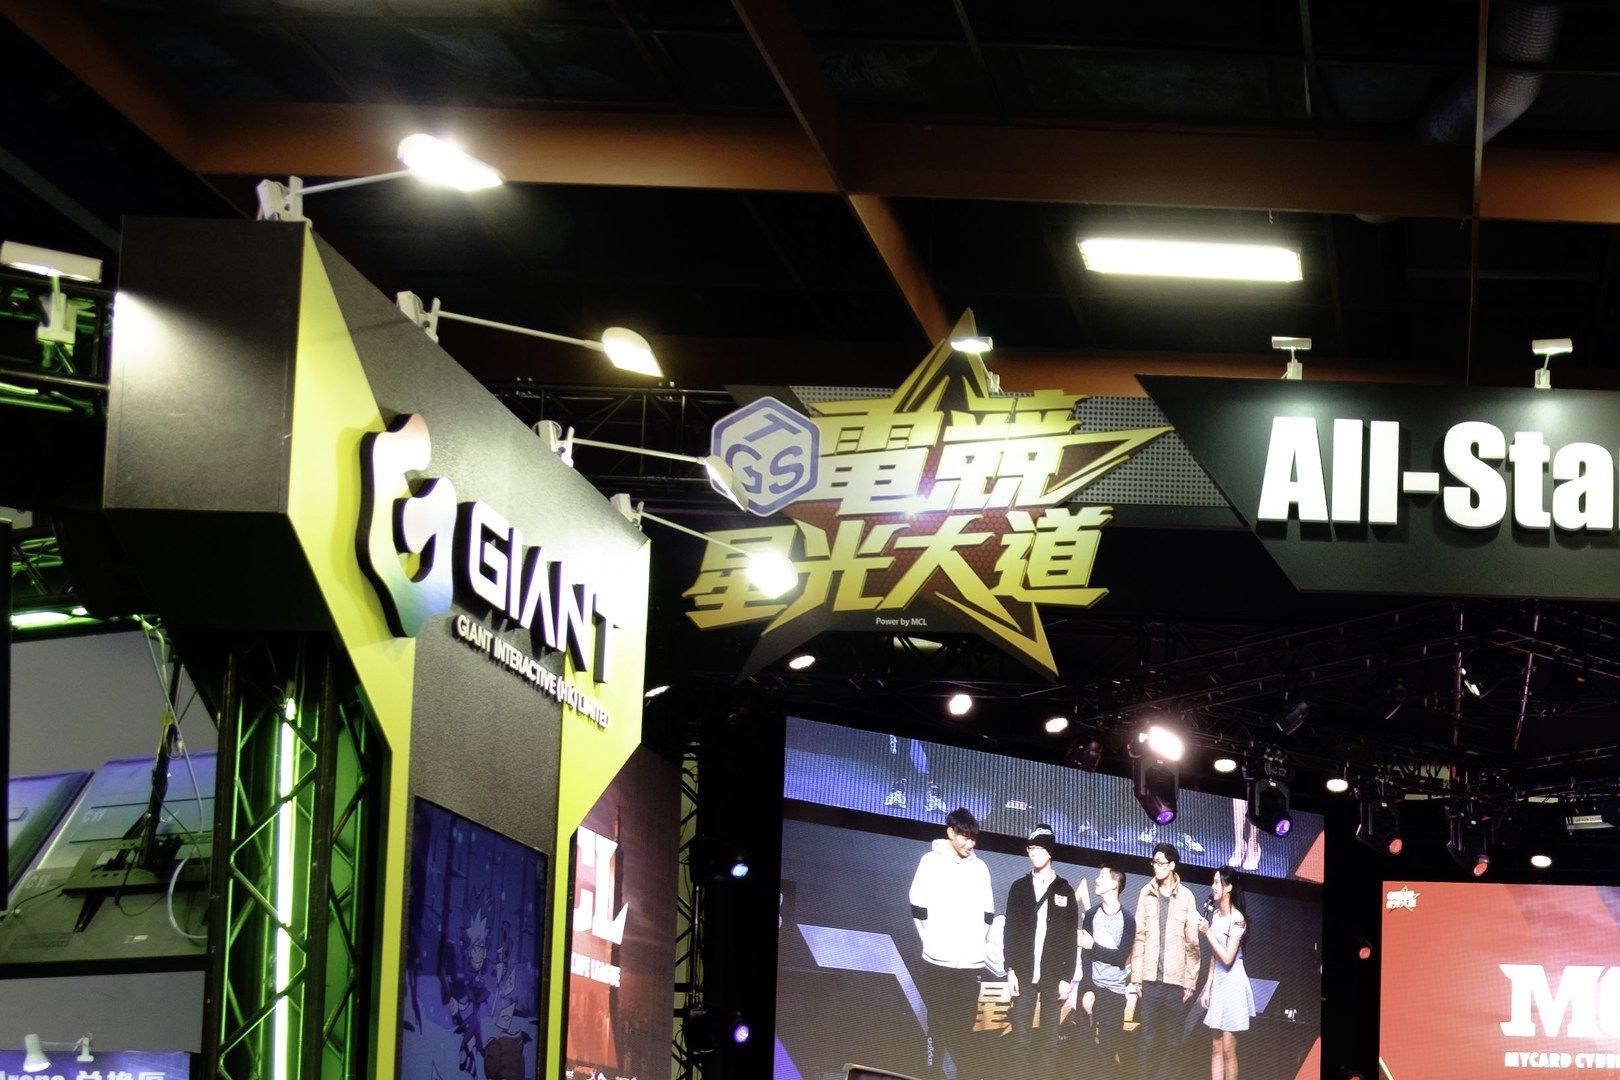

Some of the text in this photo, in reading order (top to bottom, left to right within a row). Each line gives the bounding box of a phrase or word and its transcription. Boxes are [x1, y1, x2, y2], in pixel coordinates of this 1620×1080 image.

[469, 500, 621, 683] GIANT
[680, 506, 1114, 637] 星光大道
[875, 617, 928, 627] Power by MCL
[457, 614, 493, 653] GIANT
[493, 637, 557, 695] INTERACTIVE
[575, 693, 610, 729] LIMITED
[1504, 1051, 1572, 1068] MYCARD
